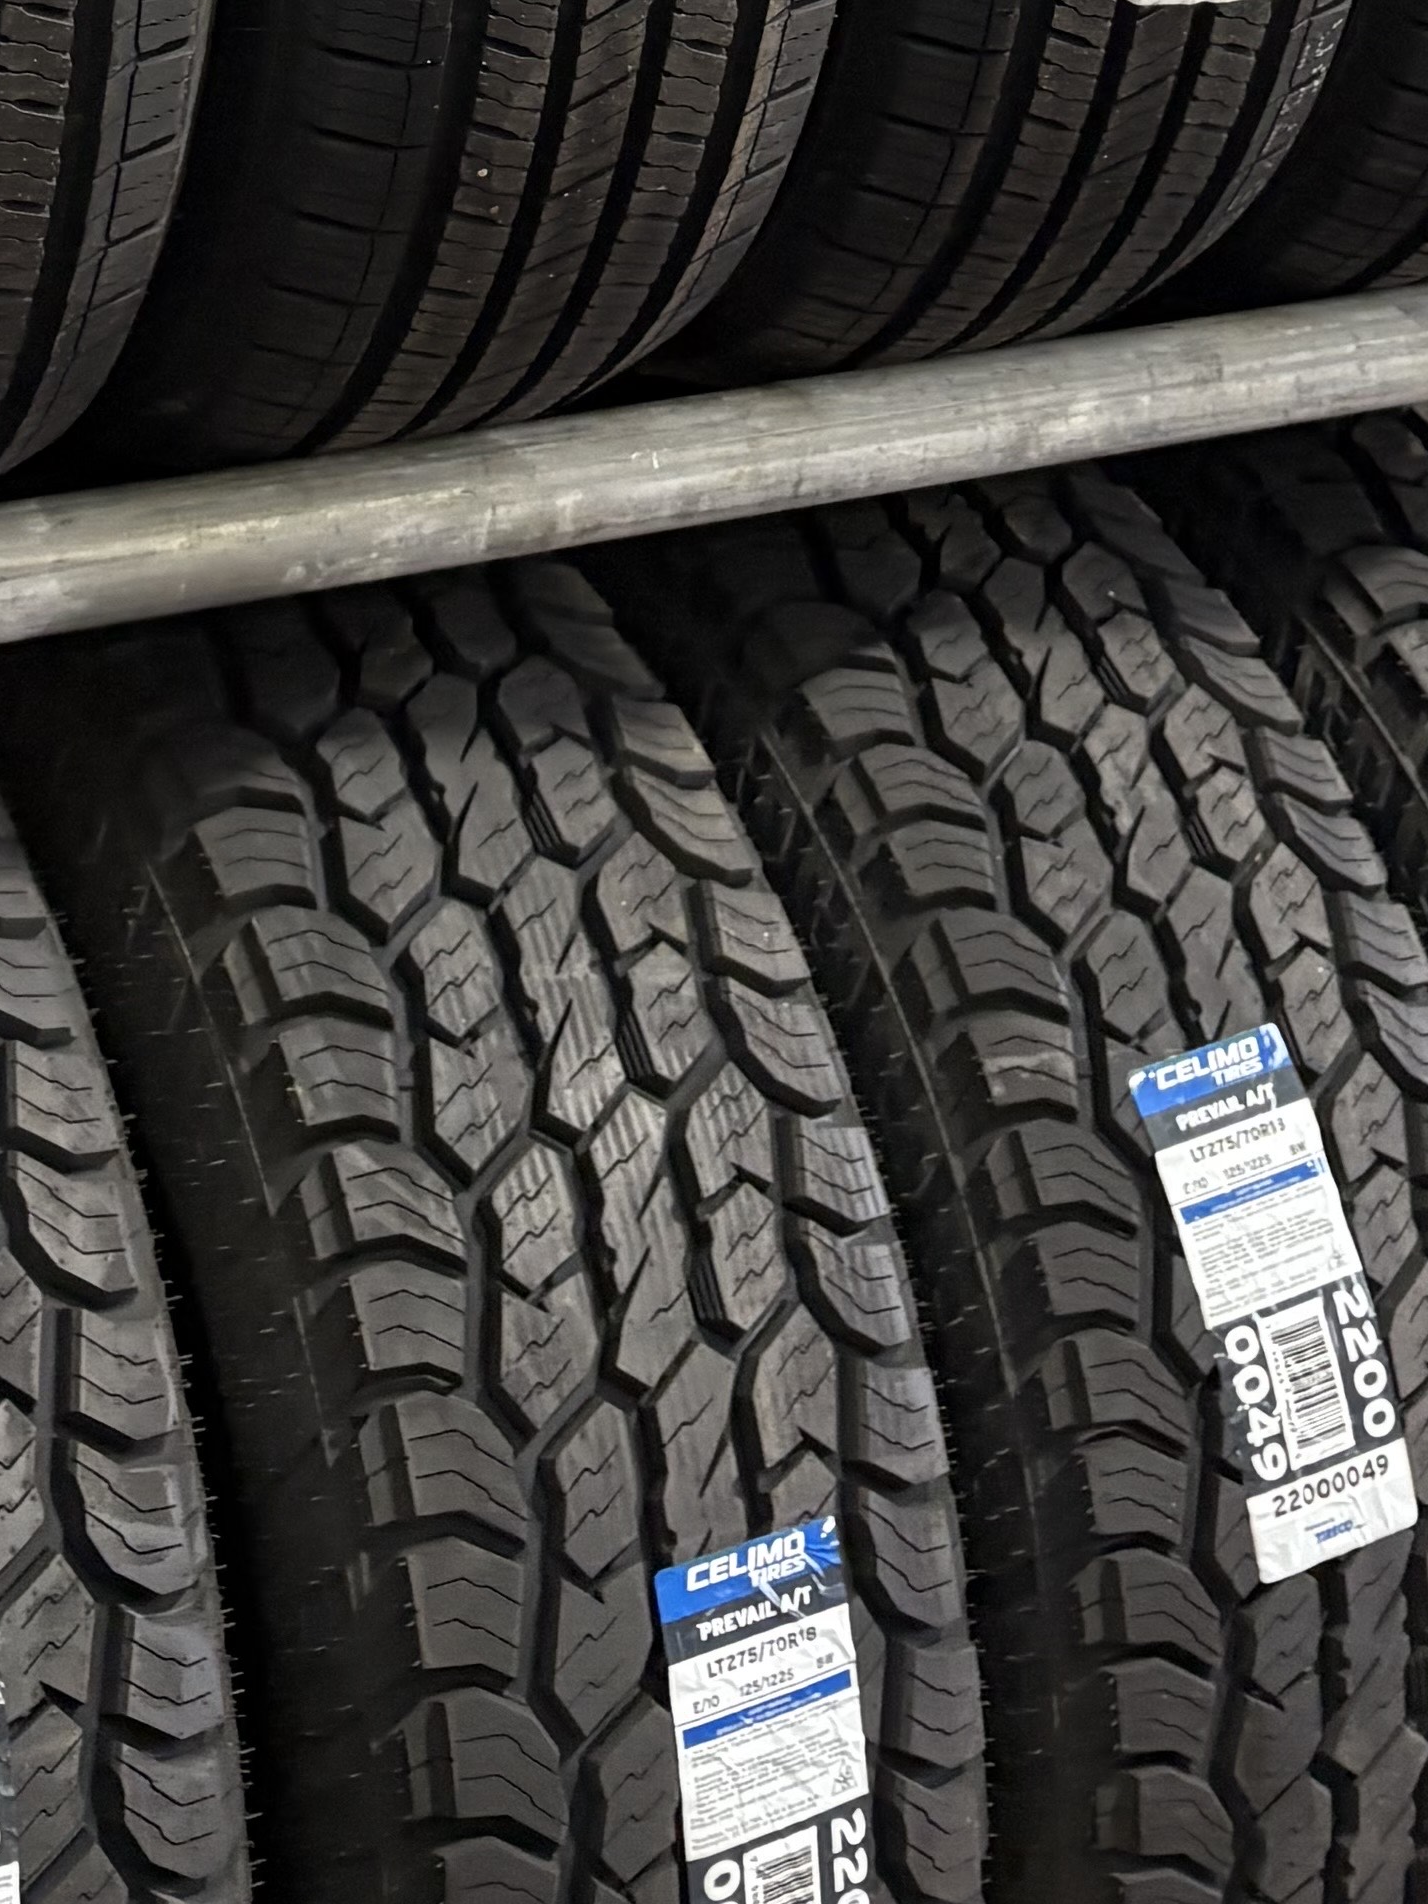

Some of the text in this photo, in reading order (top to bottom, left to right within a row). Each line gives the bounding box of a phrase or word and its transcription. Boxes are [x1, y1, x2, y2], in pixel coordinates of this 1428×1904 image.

[1156, 1037, 1260, 1090] CELIMO
[1211, 1058, 1263, 1086] TIRES
[1333, 1283, 1396, 1437] 2200
[1225, 1325, 1288, 1481] 0049
[1272, 1454, 1389, 1517] 22000049
[686, 1532, 805, 1592] CELIMO
[748, 1556, 806, 1587] TIRES
[696, 1586, 813, 1641] PREVAIL A/T
